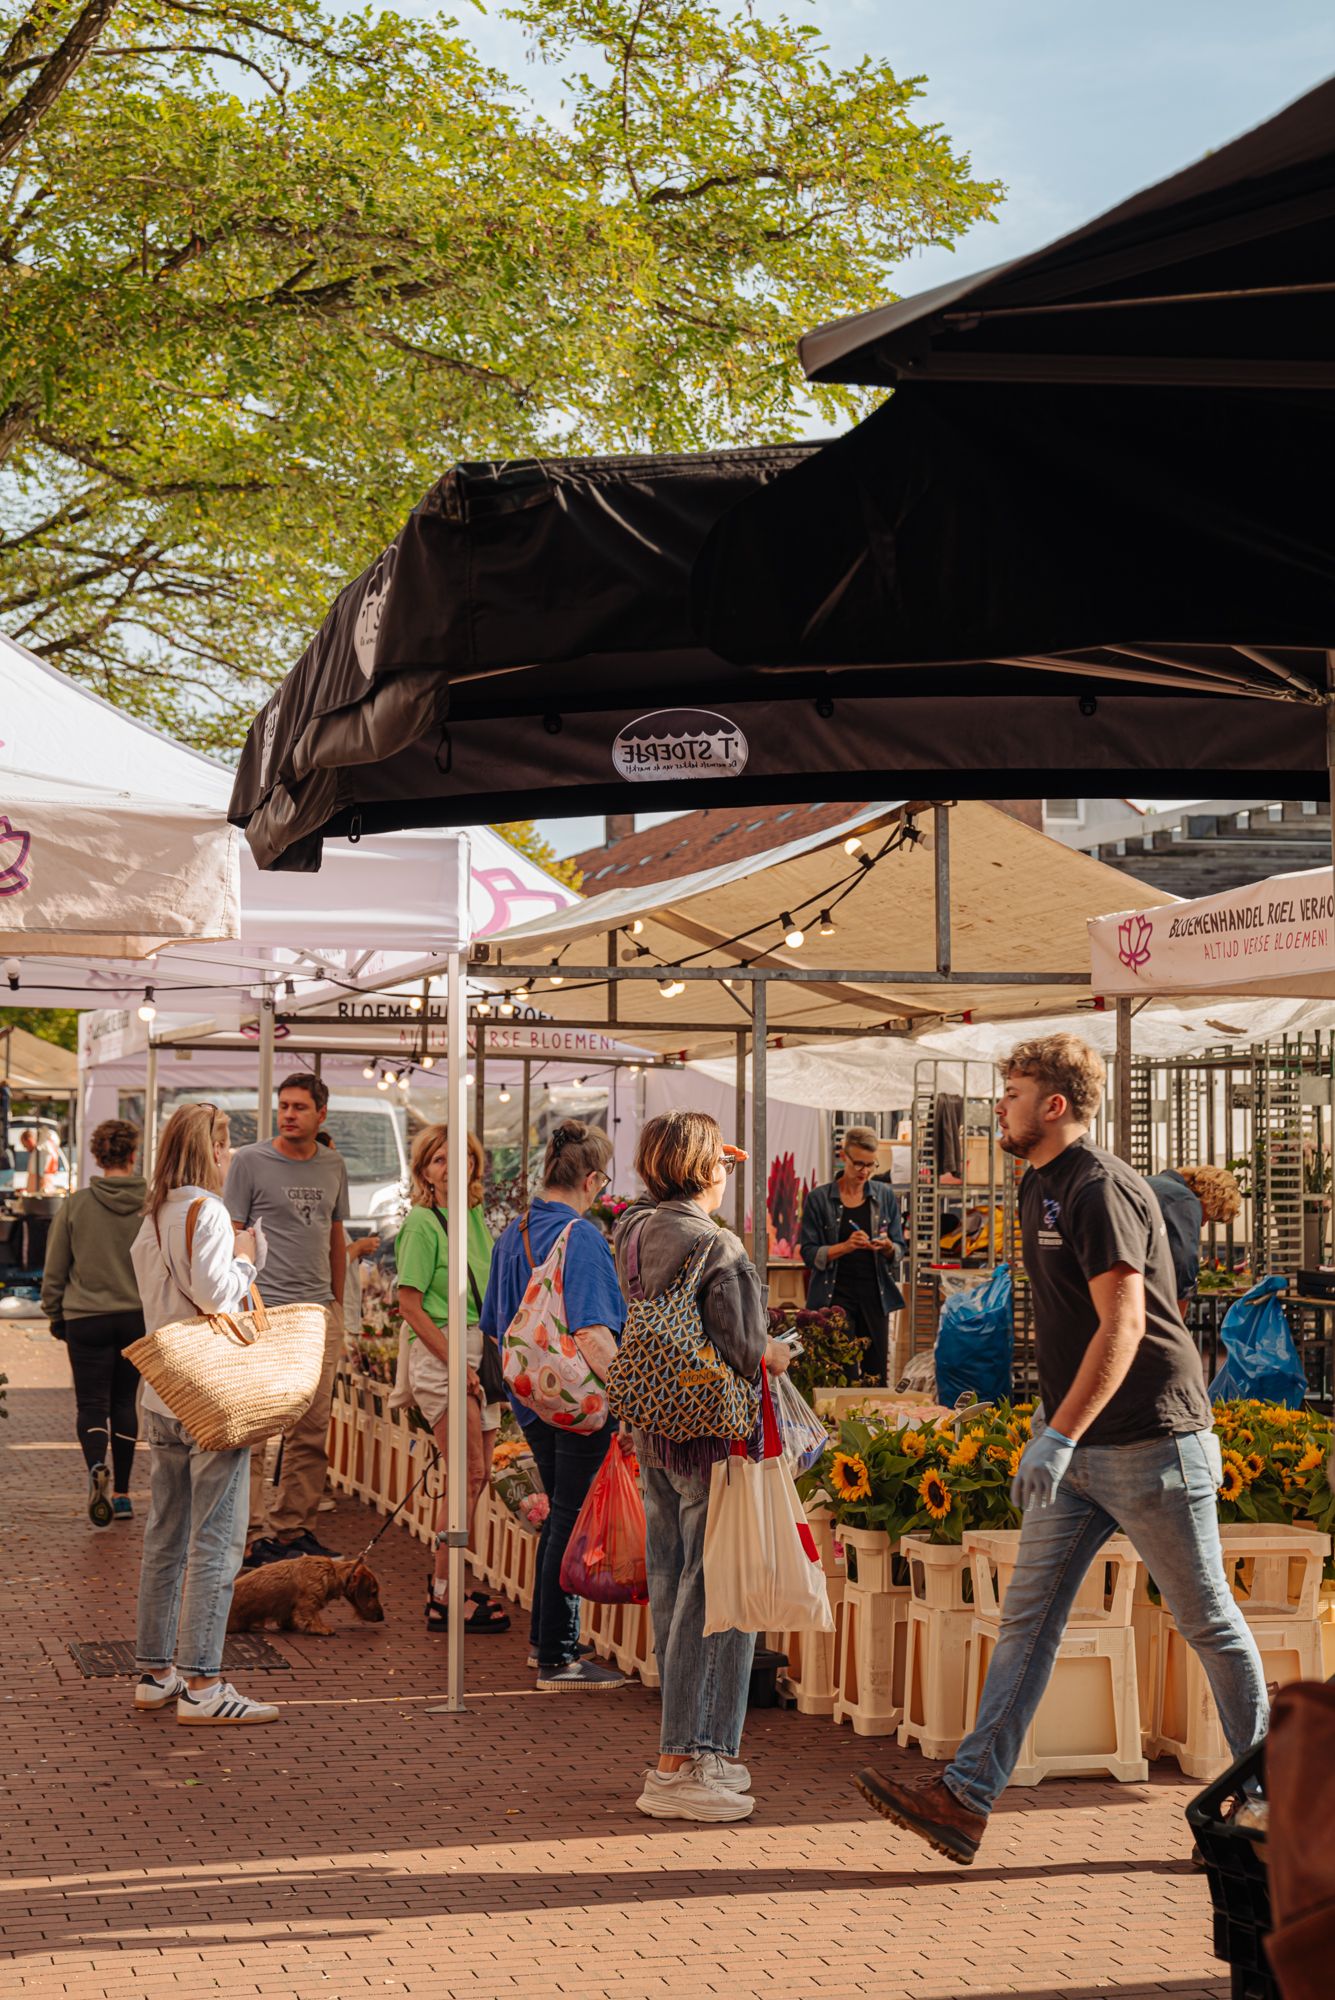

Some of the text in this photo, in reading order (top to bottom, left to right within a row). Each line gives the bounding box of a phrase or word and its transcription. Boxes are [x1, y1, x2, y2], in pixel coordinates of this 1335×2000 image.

[1168, 904, 1264, 938] BLOEMENHANDEL
[1267, 900, 1296, 926] ROEL
[1204, 940, 1239, 960] ALTIJD
[1275, 928, 1328, 951] BLOEMEN!
[530, 1031, 617, 1050] BLOEMEN!
